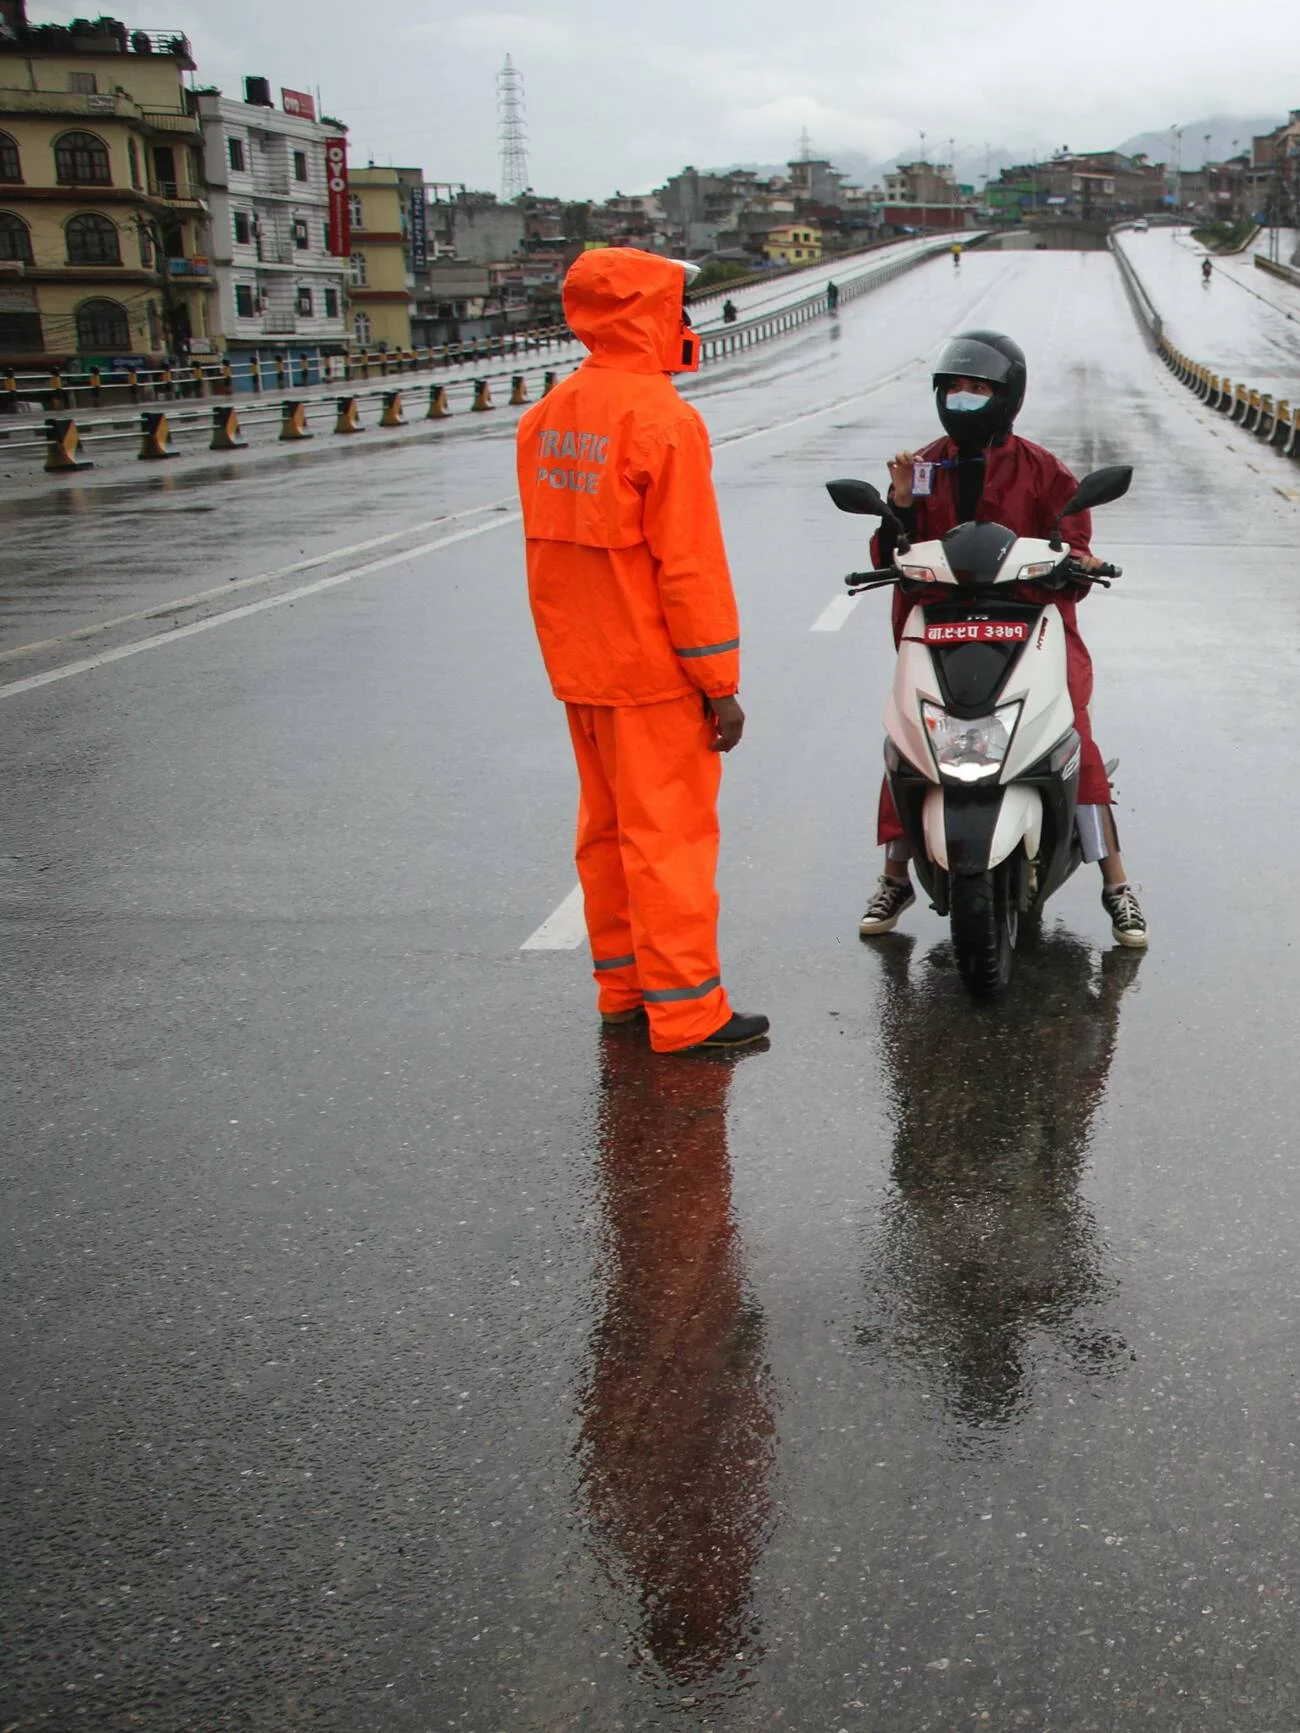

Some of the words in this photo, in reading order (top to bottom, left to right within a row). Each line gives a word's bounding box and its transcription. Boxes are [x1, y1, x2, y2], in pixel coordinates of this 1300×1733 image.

[329, 147, 345, 192] OYO
[537, 430, 609, 464] TRAFIC
[536, 467, 600, 494] POLCE
